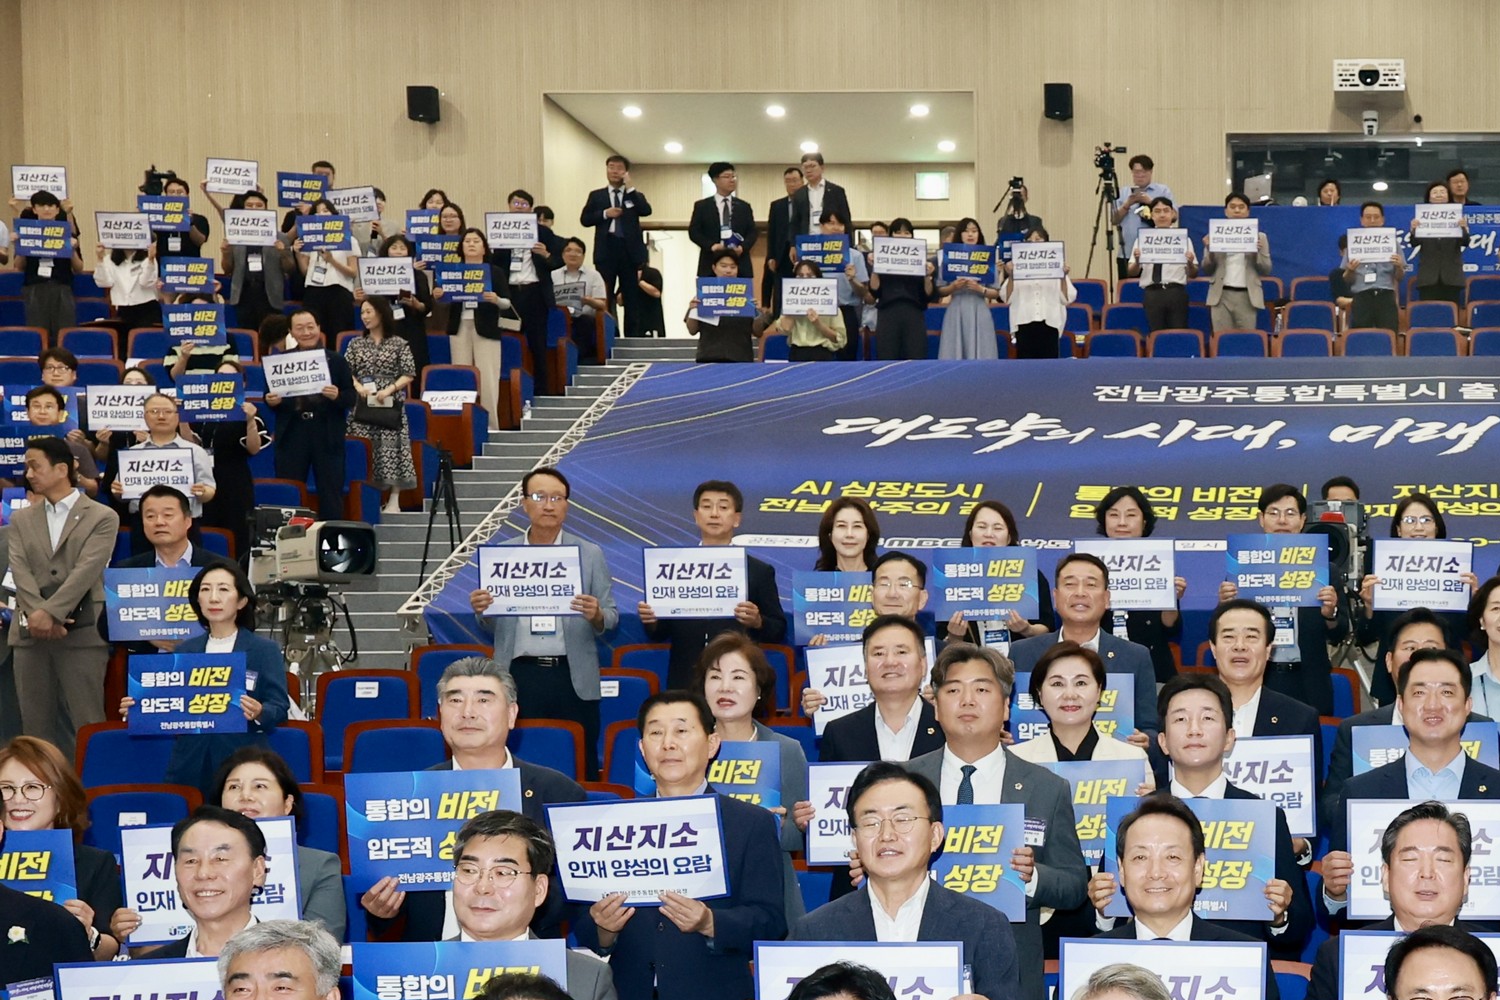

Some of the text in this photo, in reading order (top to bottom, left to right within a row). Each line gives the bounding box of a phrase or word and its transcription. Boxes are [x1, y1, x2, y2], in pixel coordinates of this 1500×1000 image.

[272, 360, 319, 375] 지산지소
[183, 382, 234, 394] 통합의 비전
[1093, 382, 1445, 403] 전남광주통합특별시
[822, 412, 1095, 455] 대도약의
[1103, 418, 1296, 451] 시대,
[1328, 415, 1500, 456] 미래
[791, 480, 984, 499] AI 심장도시
[1075, 485, 1263, 504] 통의 비전
[491, 562, 567, 579] 지산지소
[488, 584, 575, 597] 인재 양성의 요람
[141, 667, 231, 687] 통합의 비전
[141, 693, 231, 713] 압도적 성장
[573, 822, 697, 851] 지산지소
[943, 825, 1003, 853] 비전
[568, 855, 712, 878] 인재 양성의 요람
[944, 864, 1003, 892] 성장
[377, 975, 454, 1000] 통합의
